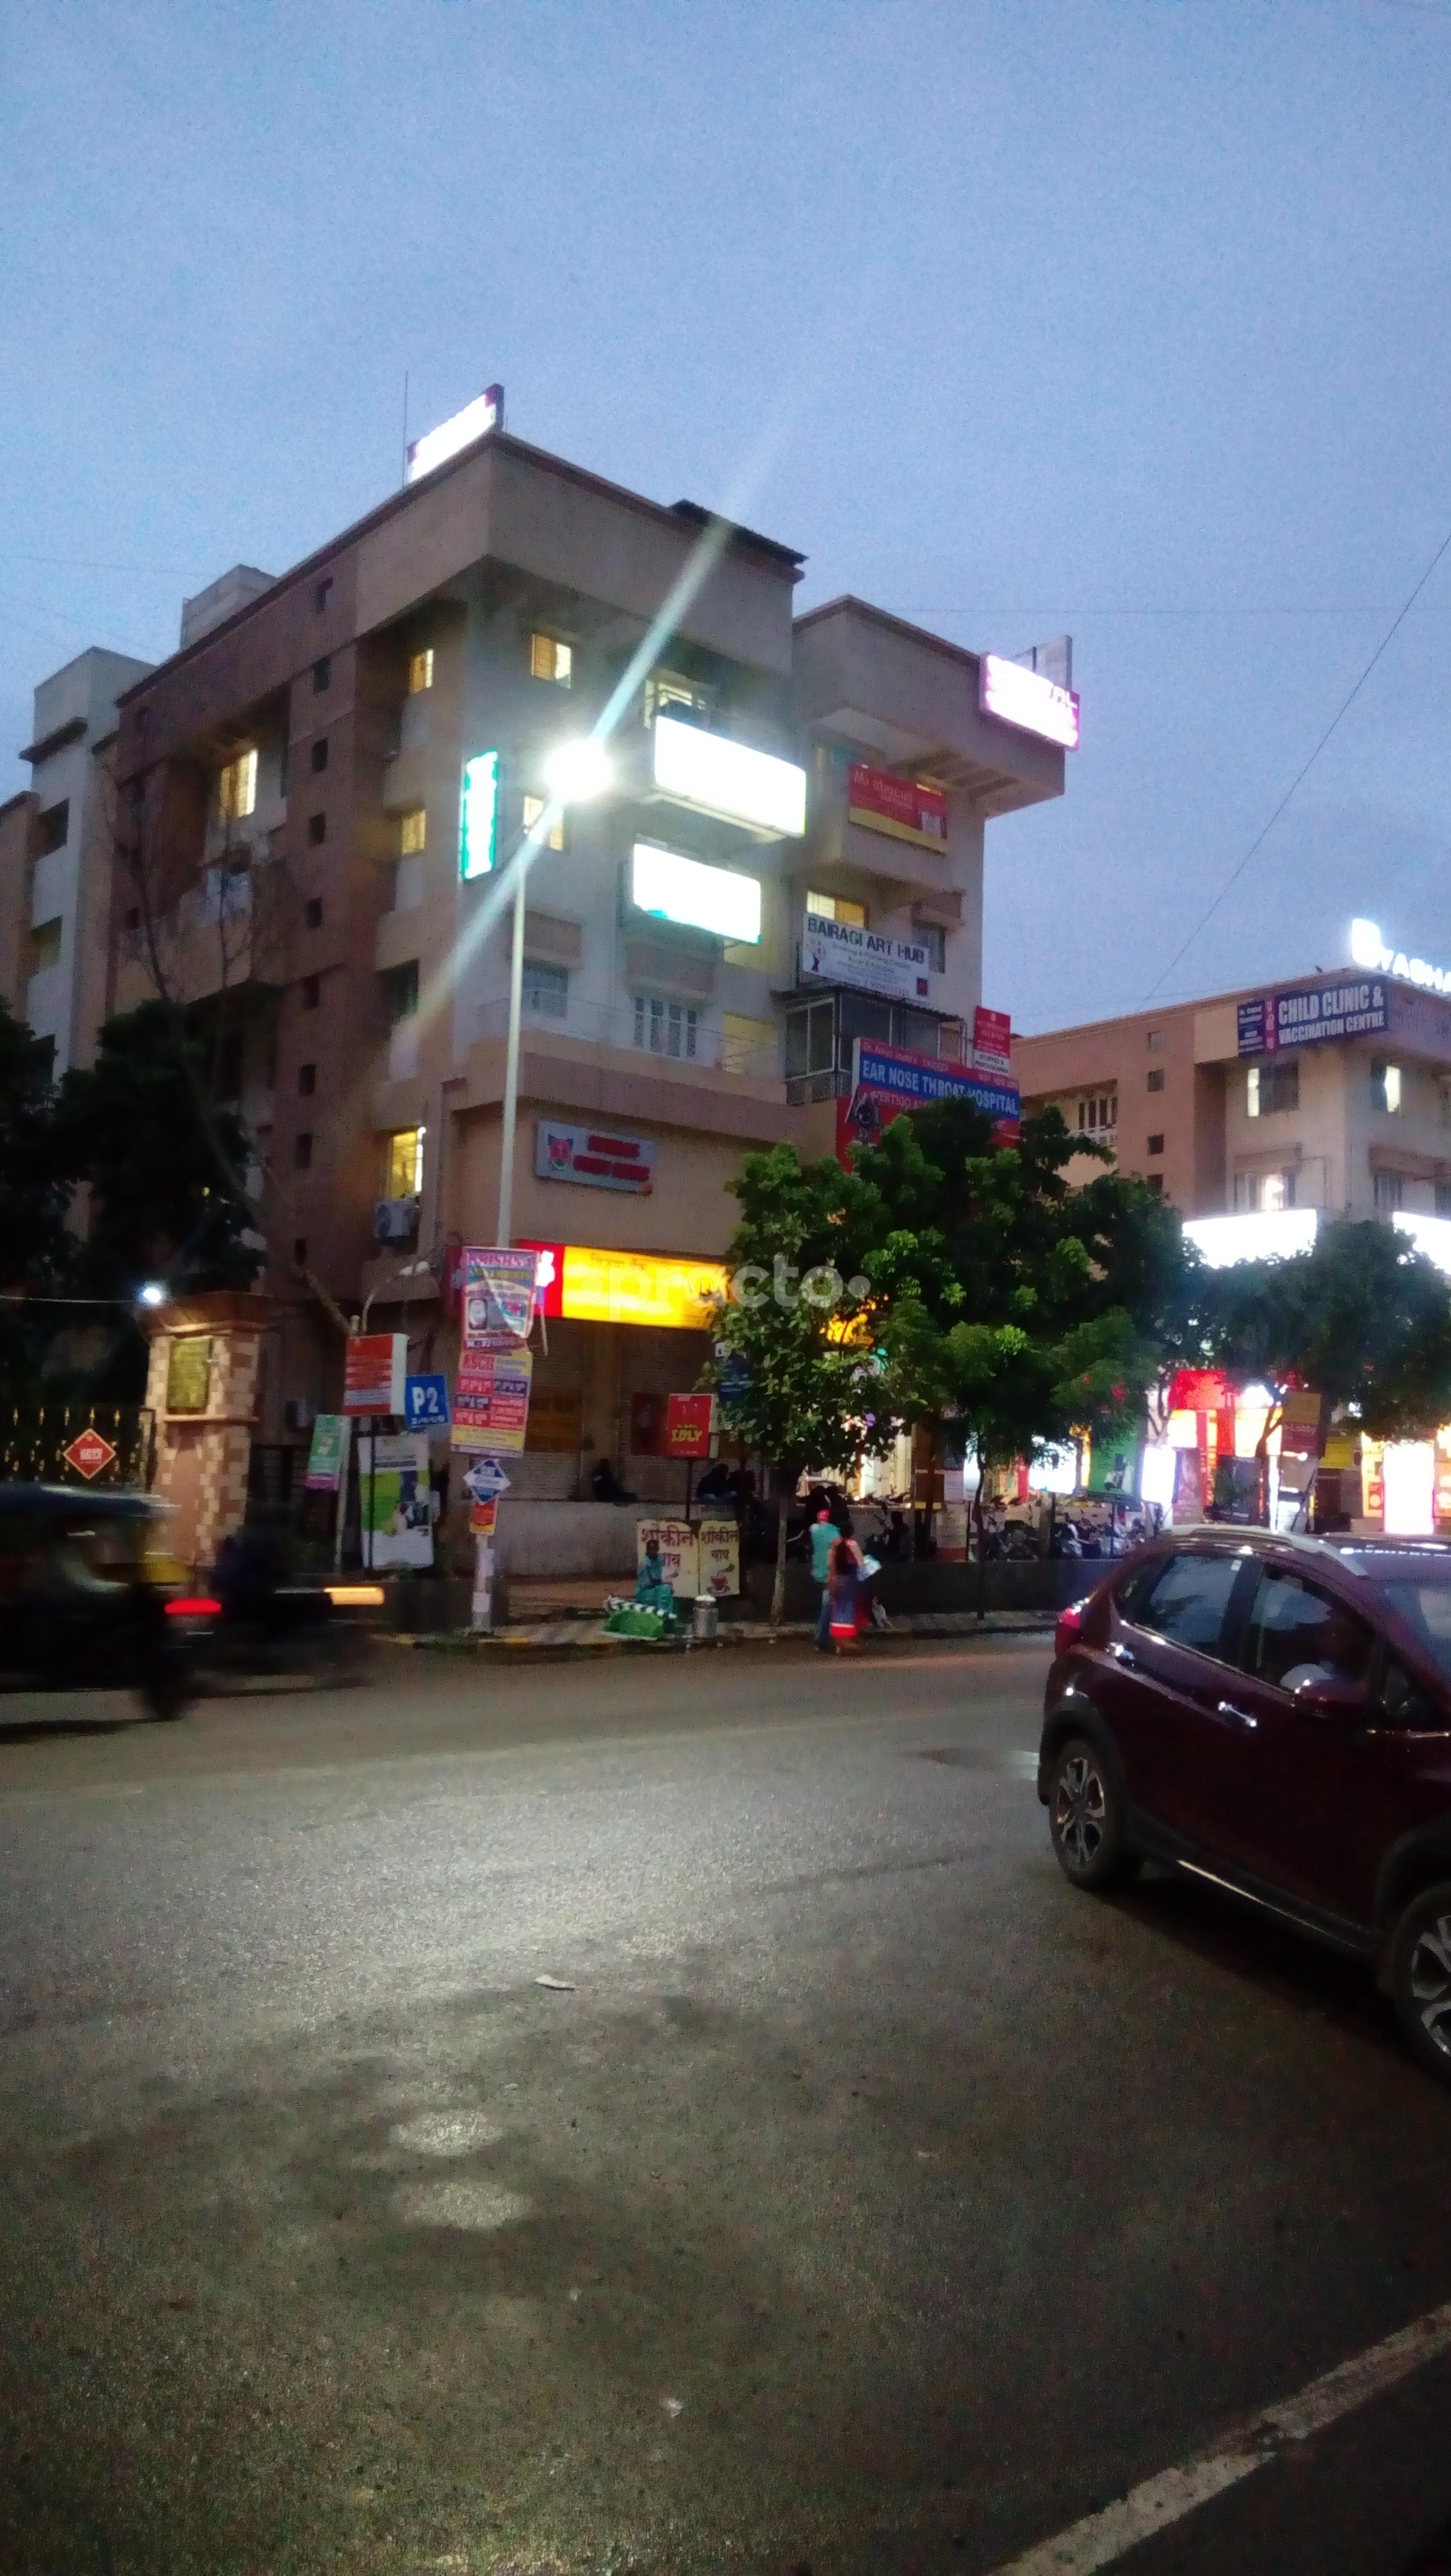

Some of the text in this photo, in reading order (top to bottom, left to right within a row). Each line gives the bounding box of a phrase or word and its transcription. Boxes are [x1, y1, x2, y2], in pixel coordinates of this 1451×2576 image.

[808, 916, 863, 947] BAIRAGI
[867, 935, 893, 955] ART
[898, 944, 925, 964] HUB
[1278, 994, 1320, 1026] CHILD
[1322, 984, 1370, 1017] CLINIC
[1372, 986, 1384, 1007] &
[1278, 1018, 1344, 1045] VACCINATION
[1345, 1011, 1386, 1033] CENTRE
[862, 1059, 886, 1083] EAR
[889, 1067, 919, 1093] NOSE
[922, 1075, 965, 1098] THROAT
[411, 1386, 439, 1415] P2
